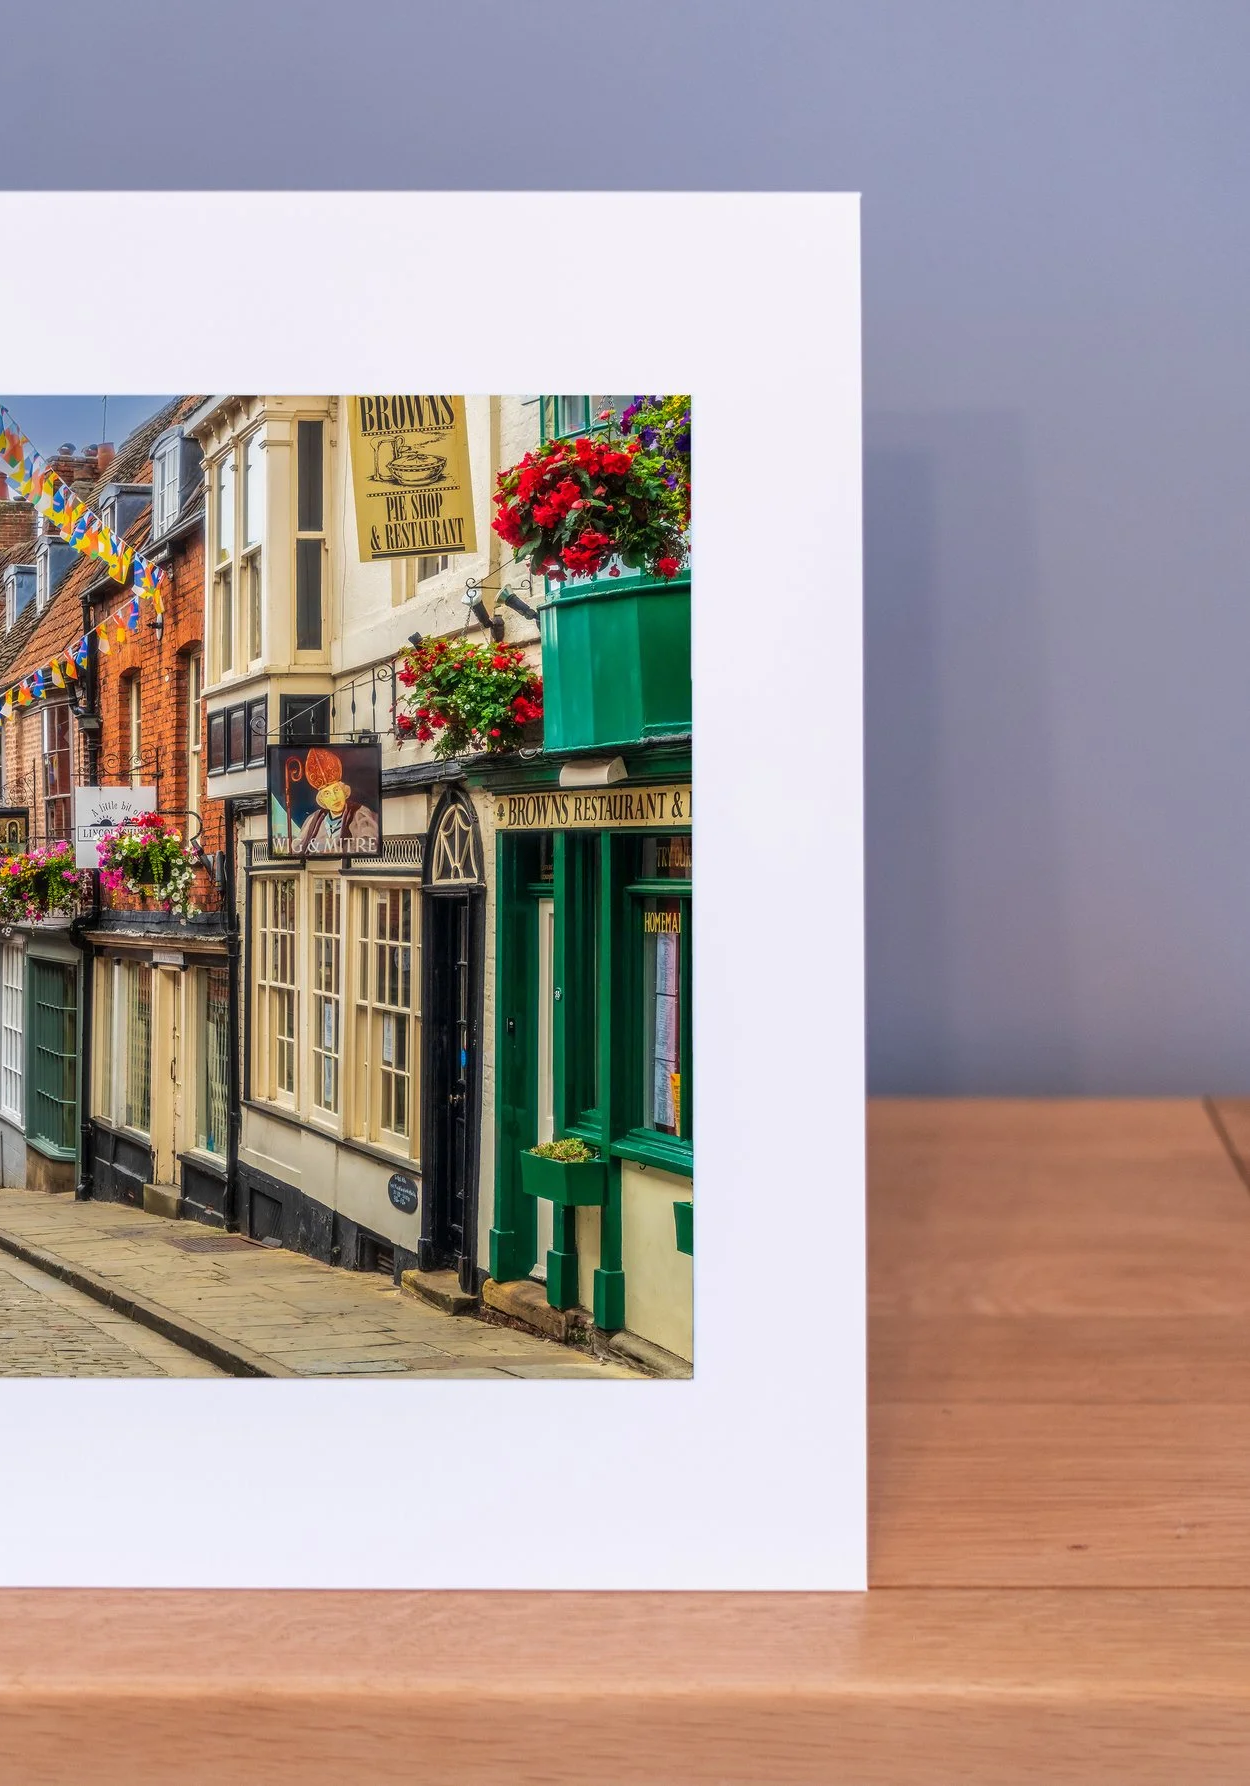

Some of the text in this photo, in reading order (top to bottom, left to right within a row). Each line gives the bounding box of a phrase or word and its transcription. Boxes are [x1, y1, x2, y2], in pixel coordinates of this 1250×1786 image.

[359, 395, 455, 432] BROWNS
[386, 492, 443, 522] PIE SHOP
[370, 518, 465, 551] & RESTAURANT
[91, 809, 99, 818] A
[99, 800, 118, 812] little
[121, 801, 132, 812] bit
[507, 794, 569, 826] BROWNS
[574, 792, 667, 821] RESTAURANT
[671, 791, 683, 818] &
[272, 837, 377, 853] WIG & MITRE
